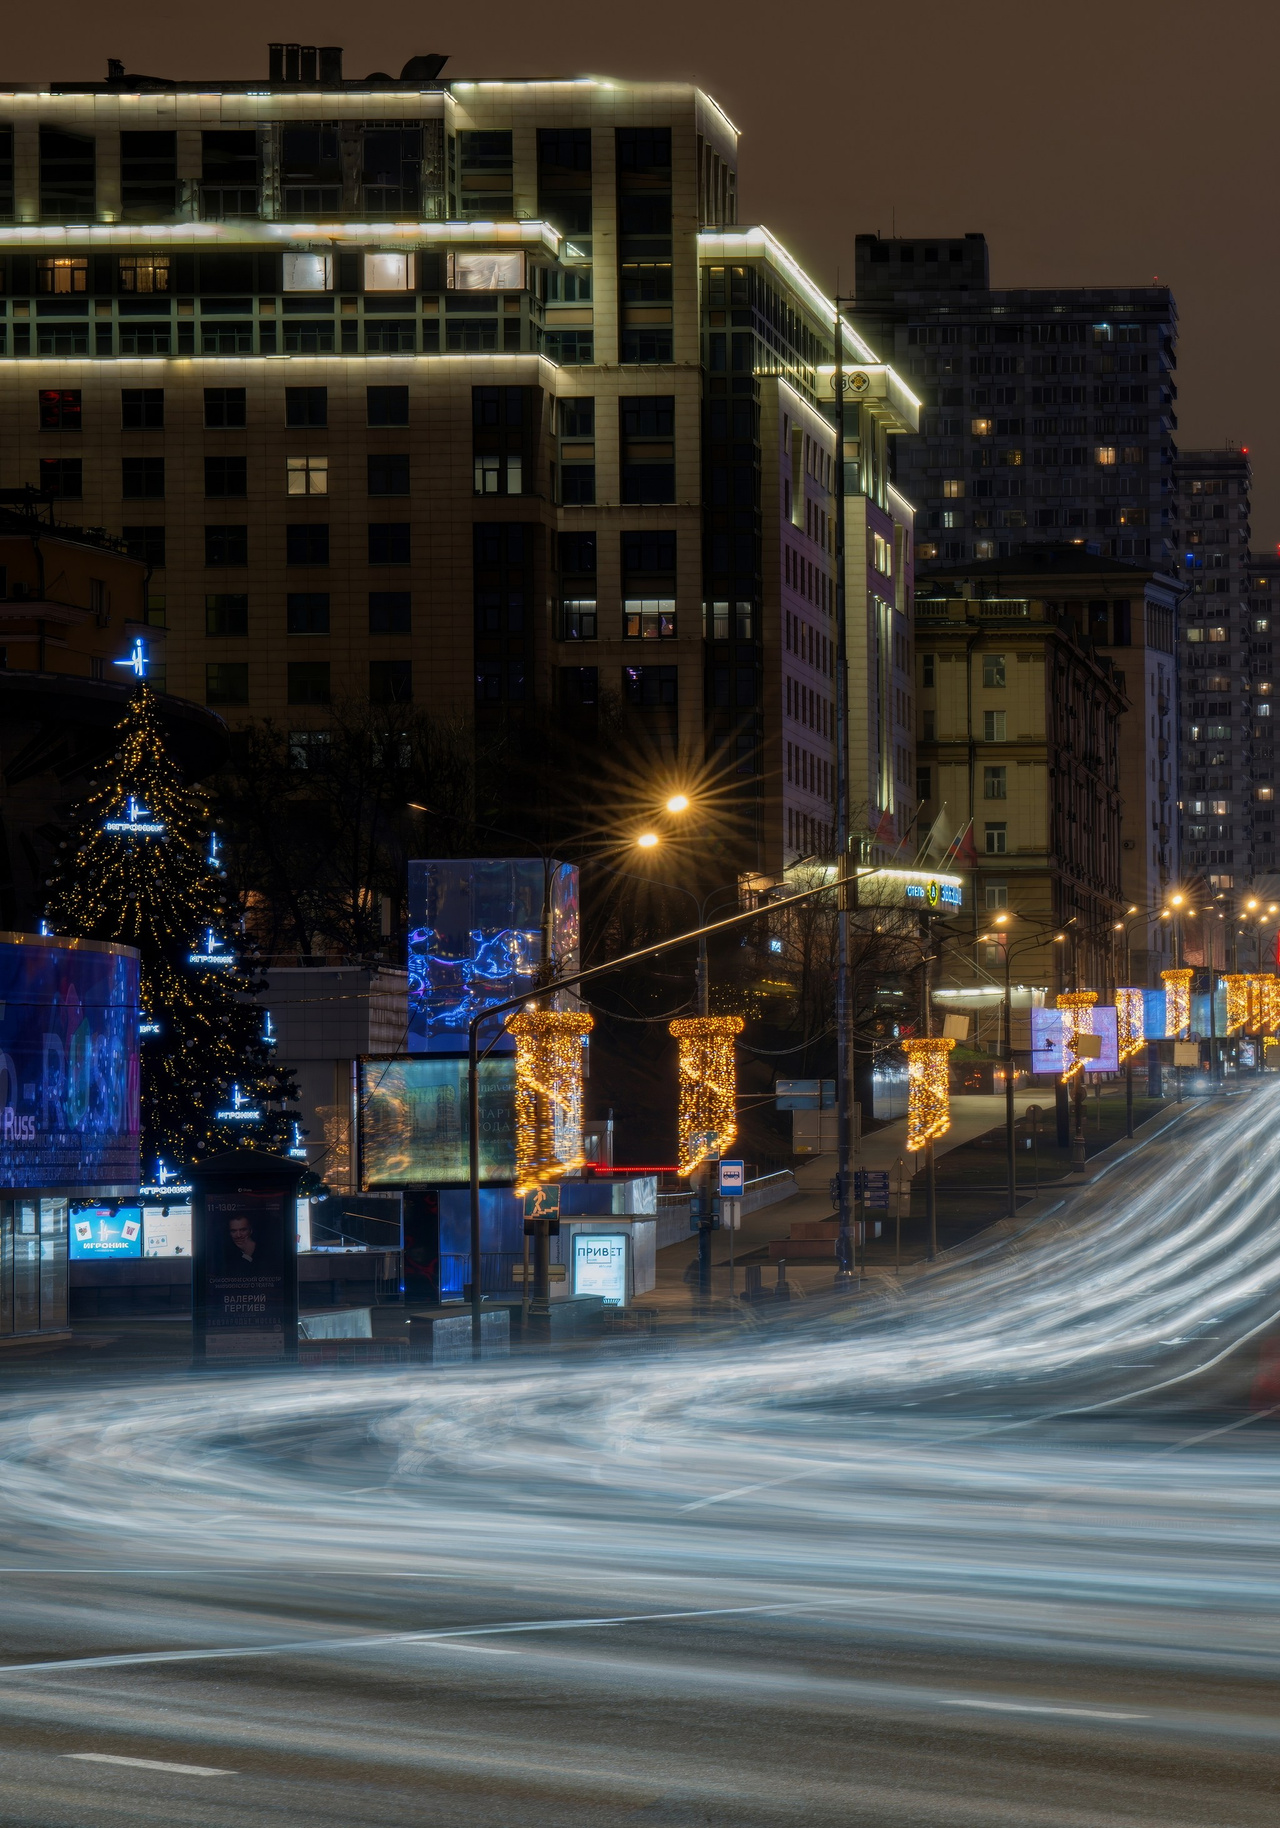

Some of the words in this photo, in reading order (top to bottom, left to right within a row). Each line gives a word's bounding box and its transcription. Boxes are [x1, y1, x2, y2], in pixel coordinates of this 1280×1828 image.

[477, 1108, 511, 1119] ТАРТ
[577, 1247, 623, 1257] ПРИВЕТ
[223, 1293, 266, 1303] ВАЛЕРИЙ
[224, 1304, 266, 1313] ГЕРГИЕВ
